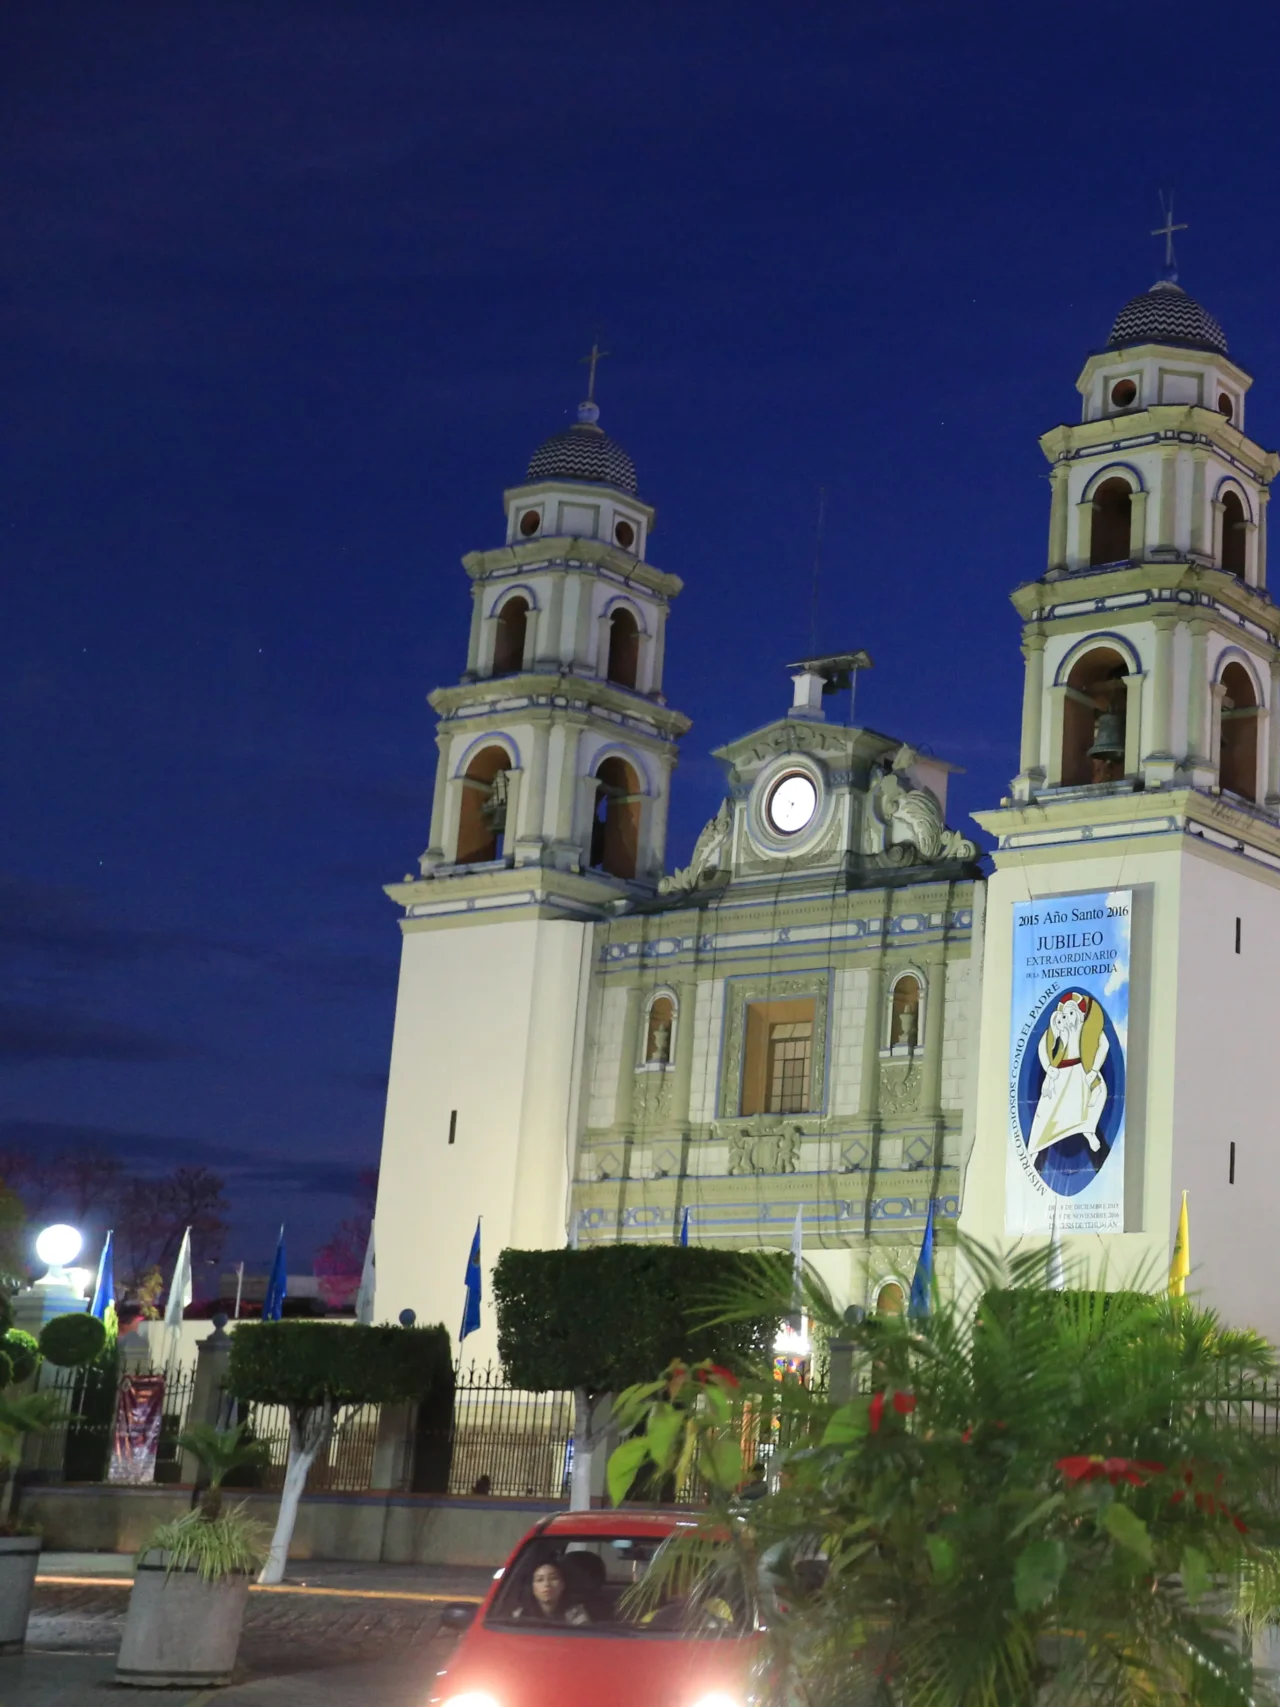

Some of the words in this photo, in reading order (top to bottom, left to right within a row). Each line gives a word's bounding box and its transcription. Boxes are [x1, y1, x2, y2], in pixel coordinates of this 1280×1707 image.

[1018, 914, 1039, 927] 2015
[1043, 910, 1068, 925] Año
[1071, 908, 1104, 922] Santo
[1107, 906, 1129, 918] 2016
[1037, 931, 1104, 951] JUBILEO
[1026, 949, 1118, 967] EXTRAORDINARIO
[1041, 964, 1118, 979] MISERICORDIA
[1029, 981, 1061, 1020] PADRE
[1021, 1021, 1034, 1036] EL
[1011, 1038, 1026, 1079] COMO
[1010, 1081, 1048, 1196] MISERICORDIOSOS
